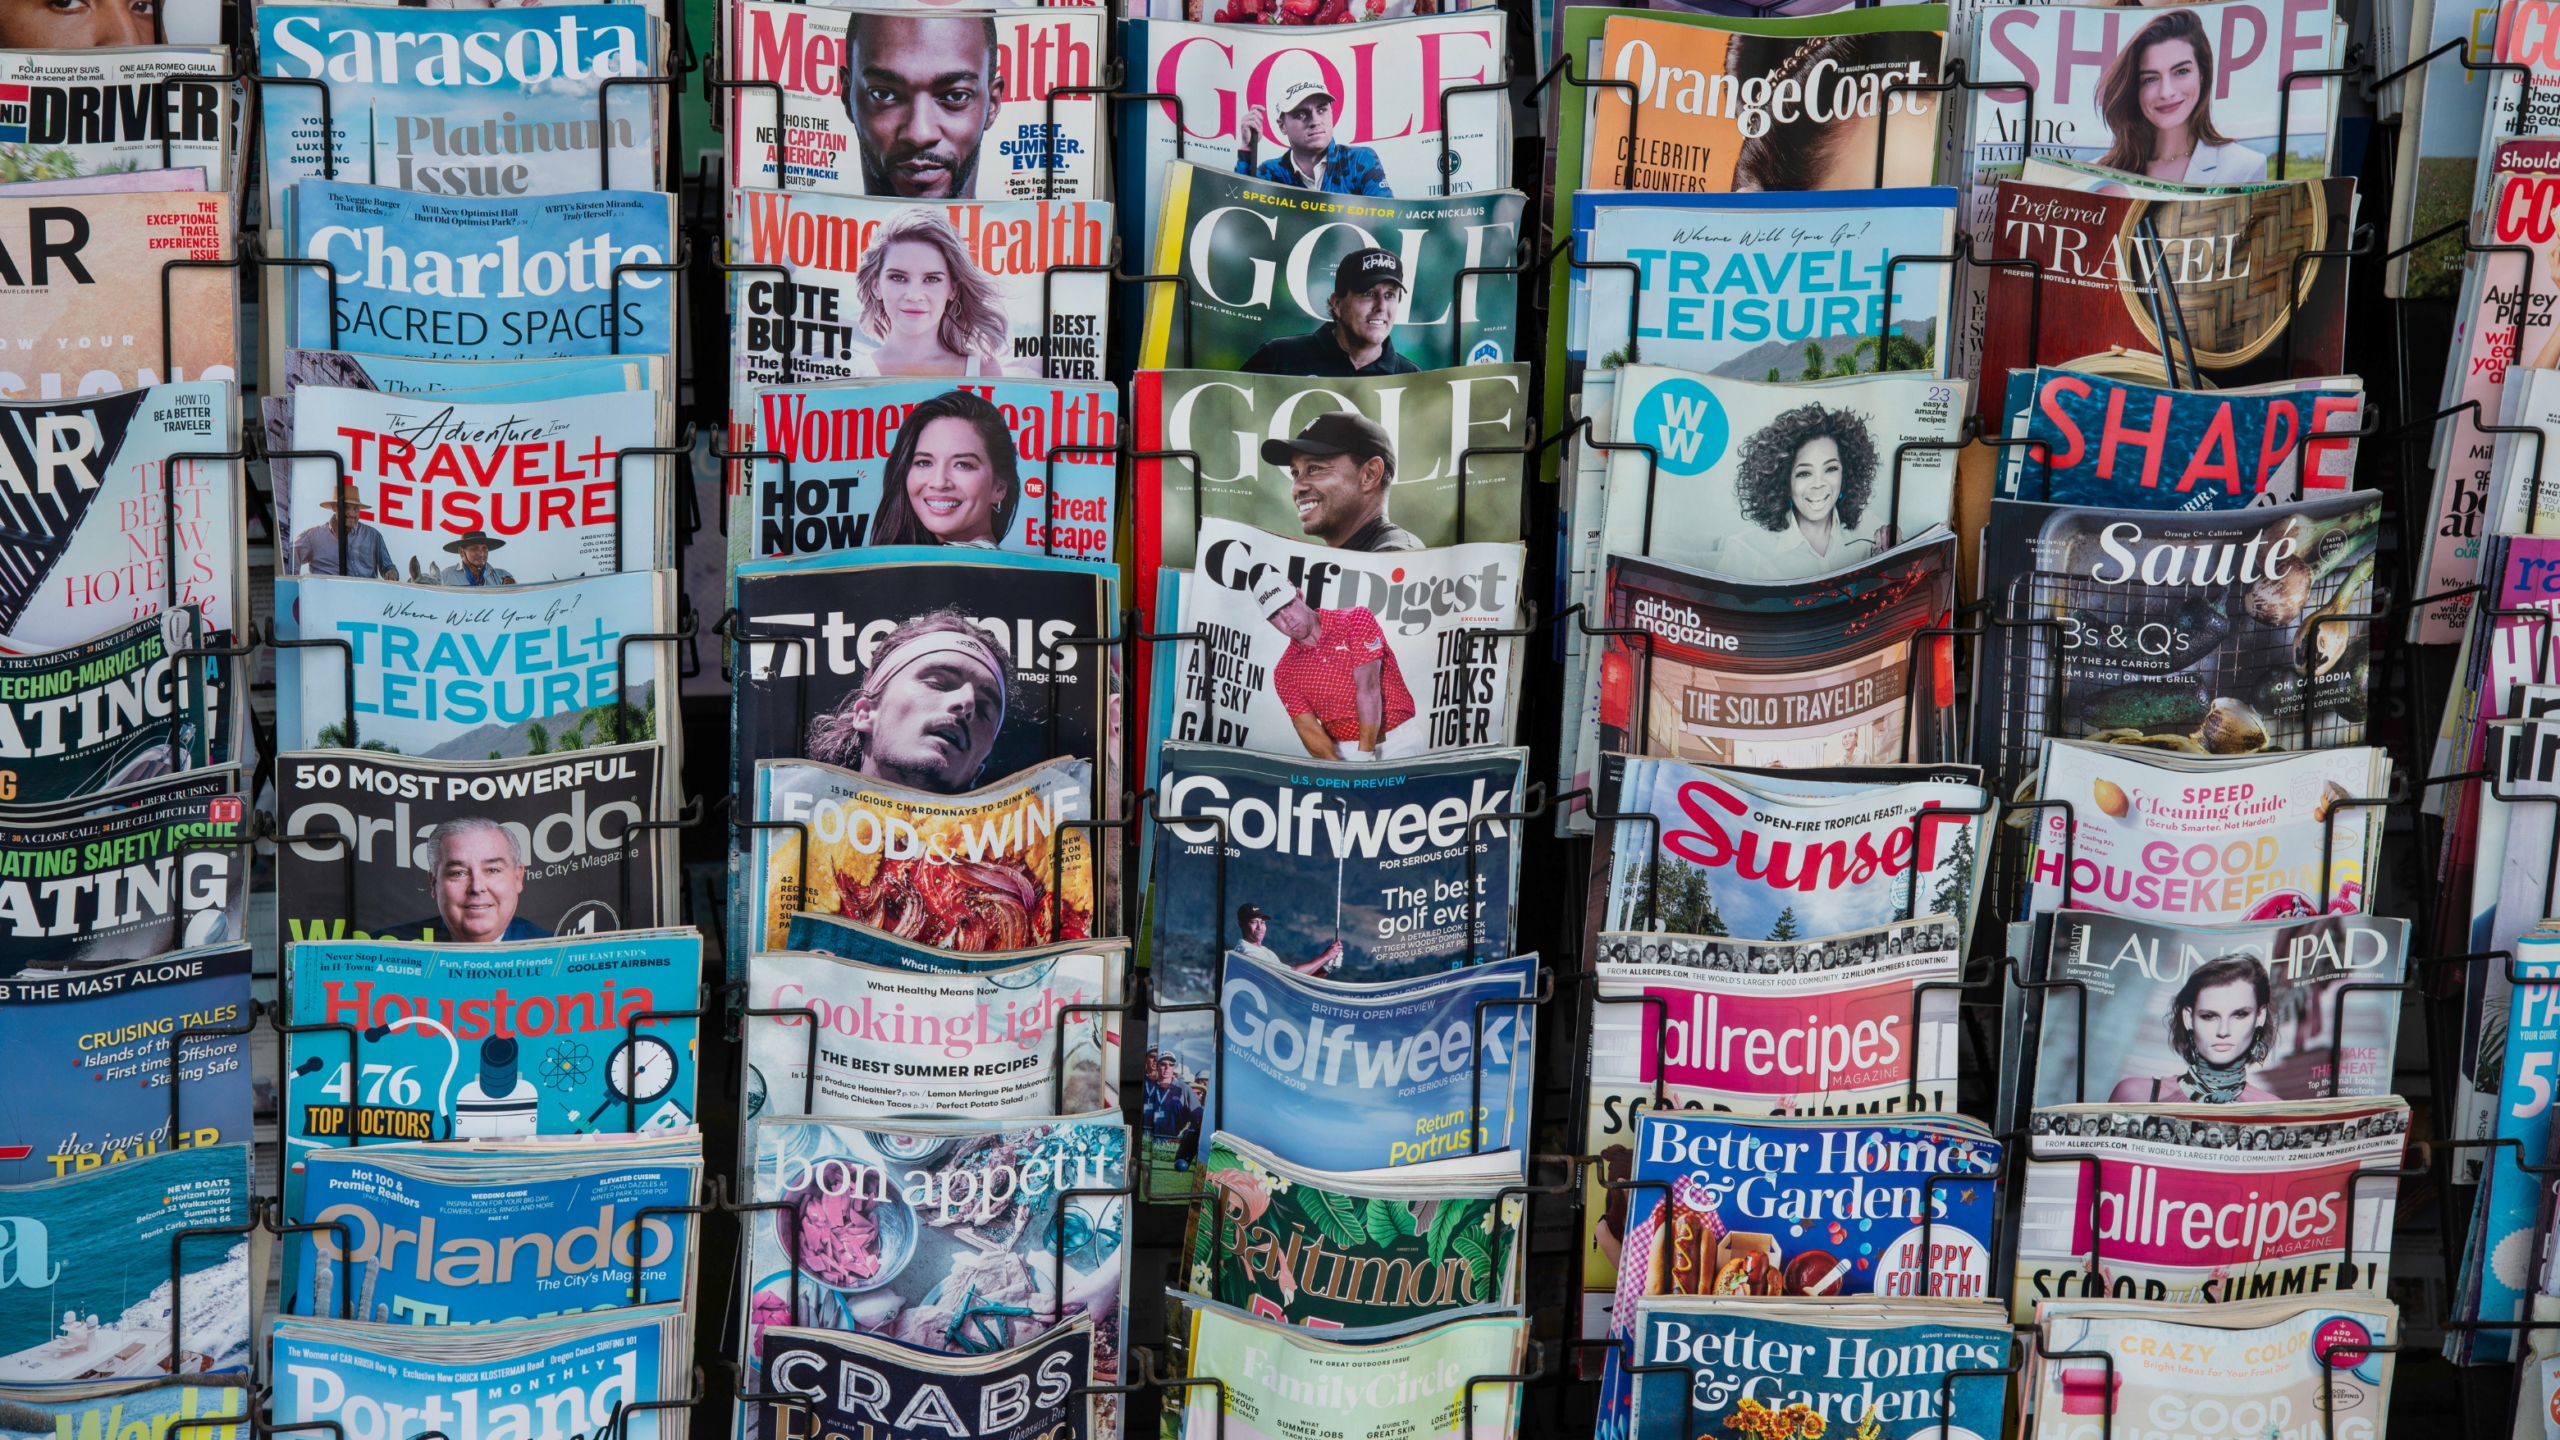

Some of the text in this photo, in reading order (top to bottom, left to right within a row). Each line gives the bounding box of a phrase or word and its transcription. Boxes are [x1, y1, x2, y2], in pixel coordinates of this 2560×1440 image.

[273, 15, 637, 86] Sarasota
[1155, 30, 1492, 148] GOLF
[1286, 81, 1325, 99] Titleist
[29, 83, 219, 144] DRIVER
[395, 112, 636, 157] Platinum
[788, 128, 847, 152] CAPTAIN
[2501, 152, 2560, 168] Should
[147, 214, 218, 225] EXCEPTIONAL
[198, 202, 218, 212] THE
[422, 206, 438, 214] Will
[460, 209, 498, 217] Optimist
[1243, 190, 1485, 220] SPECIAL GUEST EDITOR JACK NICKLAUS
[2008, 194, 2106, 226] Preferred
[150, 239, 219, 249] EXPERIENCES
[180, 226, 218, 236] TRAVEL
[191, 250, 219, 260] ISSUE
[308, 225, 664, 299] Charlotte
[1189, 206, 1514, 326] GOLF
[1362, 254, 1396, 271] KPMG
[2005, 219, 2251, 283] TRAVEL
[748, 281, 839, 323] CUTE
[1628, 294, 1902, 342] LEISURE
[334, 297, 644, 347] SACRED SPACES
[747, 317, 853, 360] BUTT!
[175, 395, 196, 405] HOW
[1929, 387, 1950, 401] 23
[175, 408, 210, 418] BETTER
[393, 406, 542, 456] Adventure
[2028, 376, 2360, 496] SHAPE
[763, 478, 859, 516] HOT
[763, 513, 869, 554] NOW
[2092, 518, 2297, 586] Sauté
[383, 594, 581, 629] Where Will You Go?
[1635, 597, 1700, 628] airbnb
[1635, 615, 1739, 651] magazine
[2121, 660, 2170, 669] CARROTS
[344, 662, 619, 724] LEISURE
[1686, 689, 1720, 721] THE
[1726, 696, 1778, 725] SOLO
[1783, 678, 1874, 724] TRAVELER
[296, 757, 636, 801] 50 MOST POWERFUL
[1291, 774, 1406, 789] U.S. OPEN PREVIEW
[2182, 784, 2254, 804] SPEED
[843, 788, 1023, 816] DELICIOUS CHARDONNAYS DRINK
[1170, 775, 1510, 859] Golfweek
[1753, 805, 1903, 831] OPEN-FIRE TROPICAL FEAST!
[2132, 788, 2287, 821] Cleaning Guide
[782, 785, 1081, 865] FOOD & WINE
[1662, 781, 1971, 892] Sunset
[2145, 815, 2276, 832] (Scrub Smarter, Harder!)
[84, 829, 161, 871] SAFETY
[1184, 846, 1213, 855] JUNE
[2142, 836, 2279, 877] GOOD
[1381, 873, 1486, 911] The best
[17, 962, 203, 1000] THE MAST ALONE
[466, 966, 543, 979] HONOLULU
[567, 958, 671, 972] COOLEST AIRBNBS
[867, 981, 998, 997] What Healthy Means Now
[78, 1005, 237, 1050] CRUISING TALES
[322, 980, 654, 1040] Houstonia
[1312, 1000, 1435, 1020] BRITISH OPEN PREVIEW
[1223, 978, 1513, 1089] Golfweek
[1661, 993, 1900, 1090] allrecipes
[821, 1050, 1038, 1077] THE BEST SUMMER RECIPES
[2341, 1048, 2377, 1059] TAKE
[321, 1062, 421, 1106] 476
[1833, 1067, 1898, 1086] MAGAZINE
[99, 1132, 143, 1156] joys
[1647, 1122, 1993, 1174] Better Homes
[168, 1179, 230, 1194] NEW BOATS
[172, 1189, 230, 1202] Horizon FD77
[329, 1179, 420, 1208] Premier Realtors
[351, 1169, 392, 1187] Hot 100
[774, 1139, 1113, 1223] bon appétit
[1684, 1170, 1948, 1220] & Gardens
[184, 1208, 217, 1218] Summit
[2090, 1165, 2341, 1259] allrecipes
[313, 1204, 673, 1286] Orlando
[2266, 1236, 2332, 1256] MAGAZINE
[1351, 1359, 1390, 1367] OUTDOORS
[1391, 1356, 1410, 1364] ISSUE
[1651, 1321, 1999, 1379] Better Homes
[2120, 1331, 2308, 1364] CRAZY COLOR
[403, 1364, 526, 1383] Exclusive CHUCK KLOSTERMAN
[489, 1359, 606, 1399] MONTHLY
[288, 1350, 642, 1440] Portland
[770, 1350, 1074, 1438] CRABS
